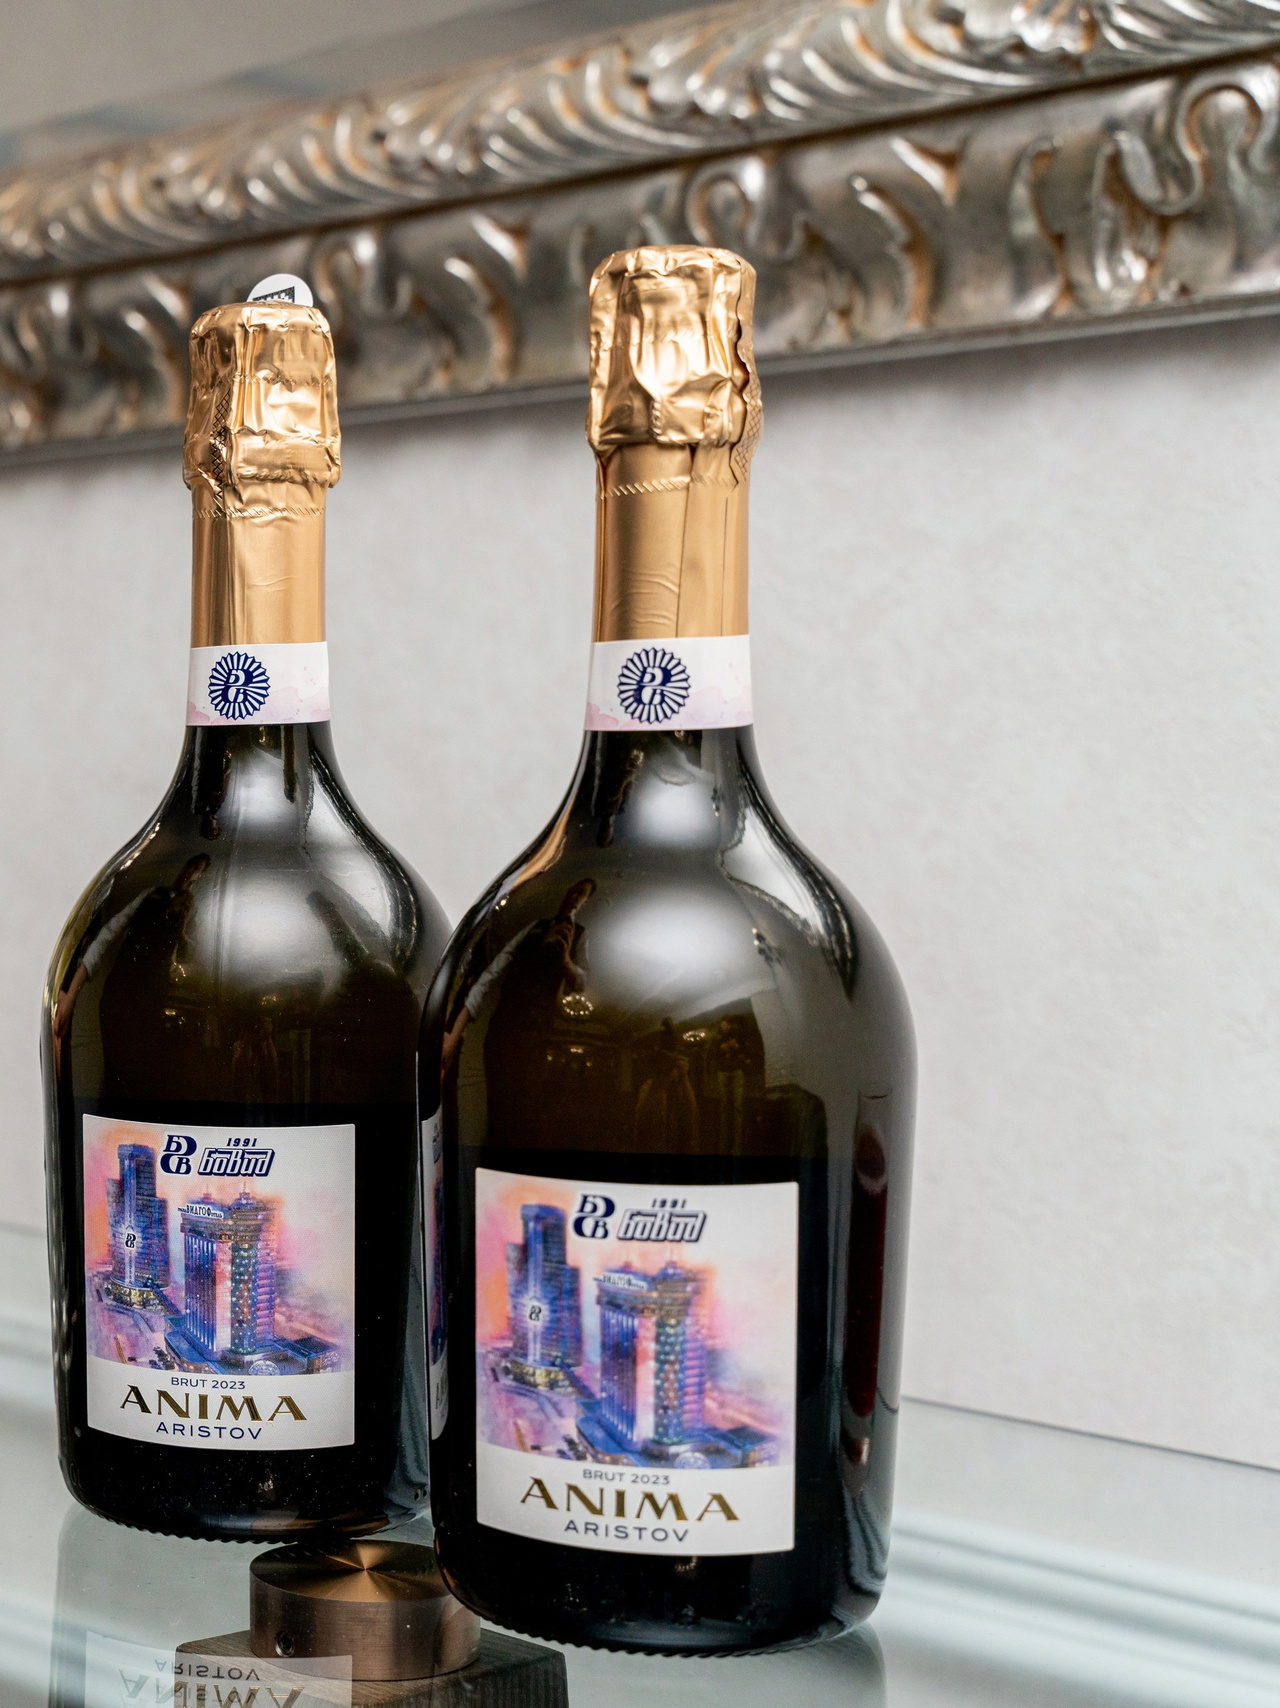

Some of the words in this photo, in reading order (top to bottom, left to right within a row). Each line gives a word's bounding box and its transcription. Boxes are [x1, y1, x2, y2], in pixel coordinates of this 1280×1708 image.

[226, 1138, 258, 1147] 1991
[651, 1198, 686, 1209] 1991
[171, 1377, 207, 1388] BRUT
[211, 1379, 246, 1390] 2023
[120, 1384, 307, 1422] ANIMA
[156, 1422, 262, 1440] ARISTOV
[582, 1469, 625, 1482] BRUT
[631, 1473, 670, 1485] 2023
[520, 1476, 740, 1522] ANIMA
[564, 1519, 689, 1542] ARISTOV
